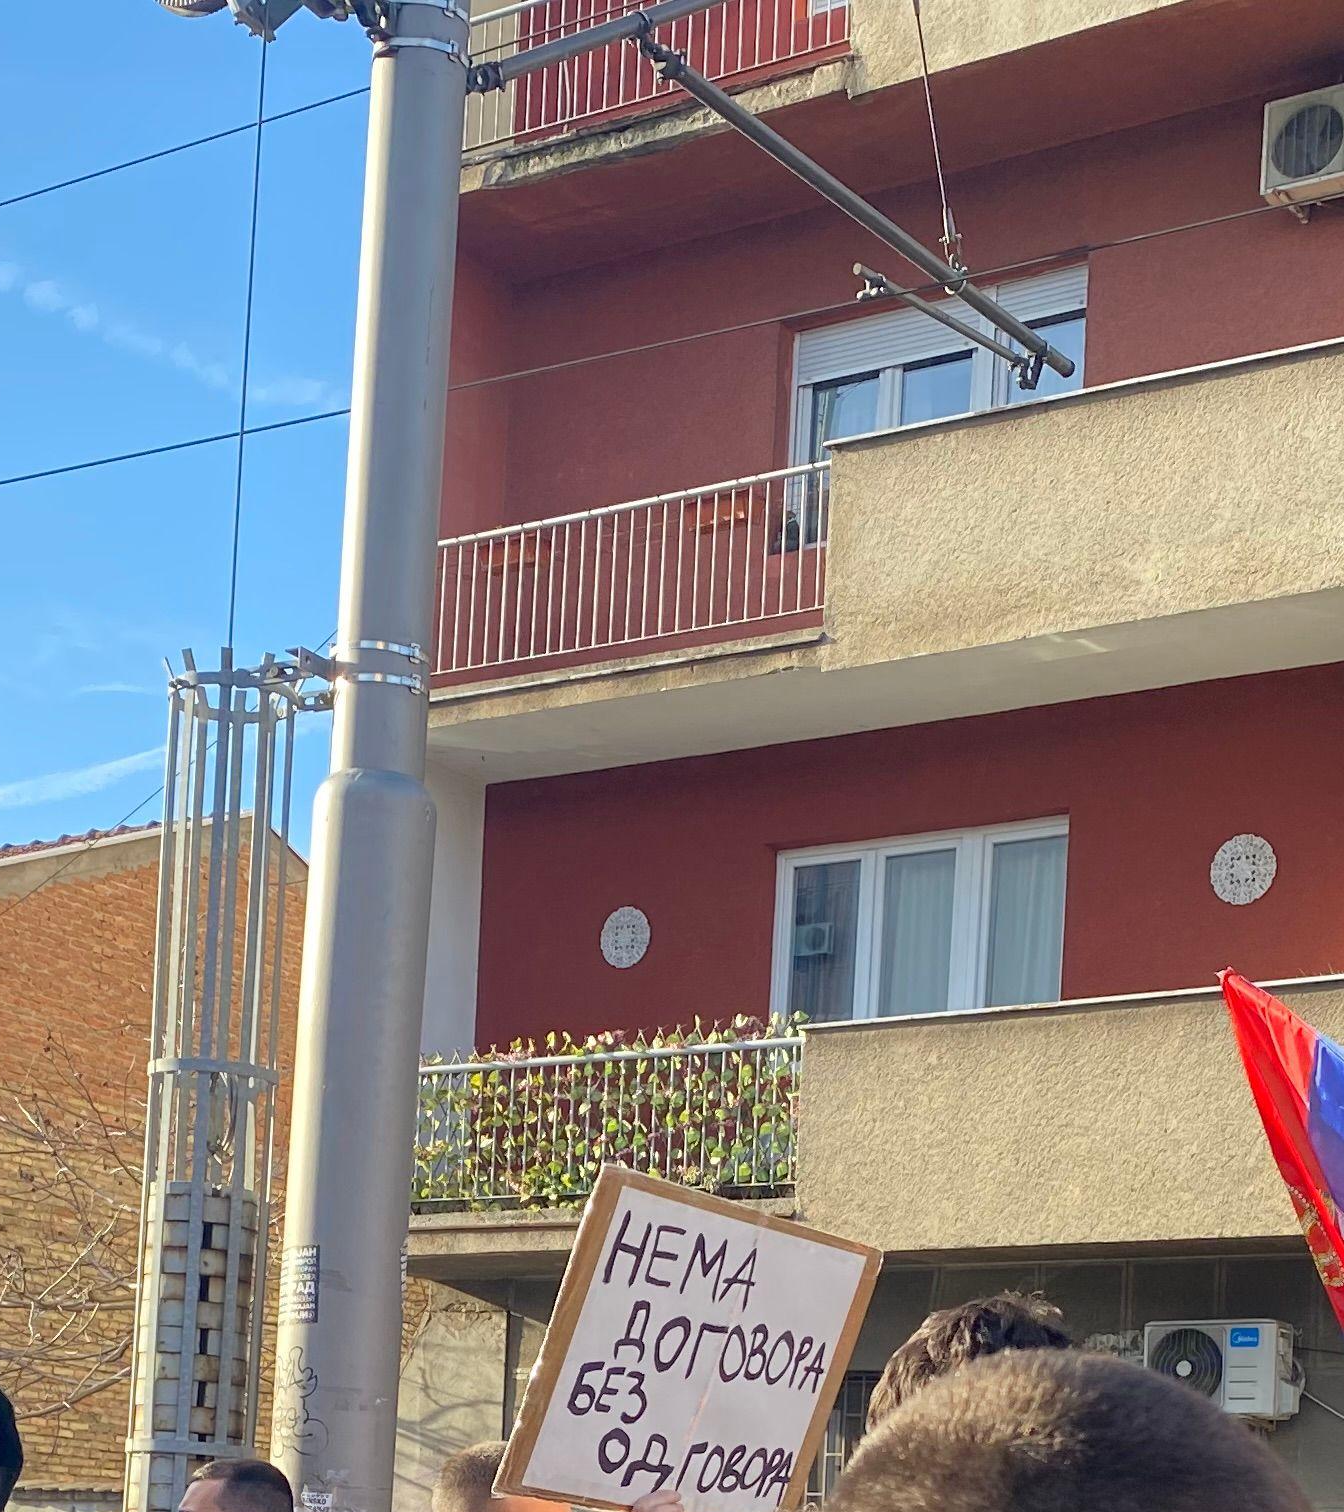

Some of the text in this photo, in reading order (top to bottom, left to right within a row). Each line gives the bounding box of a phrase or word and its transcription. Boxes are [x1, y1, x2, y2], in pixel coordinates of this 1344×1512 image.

[602, 1209, 757, 1312] НЕМА
[566, 1360, 648, 1425] БЕЗ
[613, 1300, 827, 1394] ДОГОВОРА
